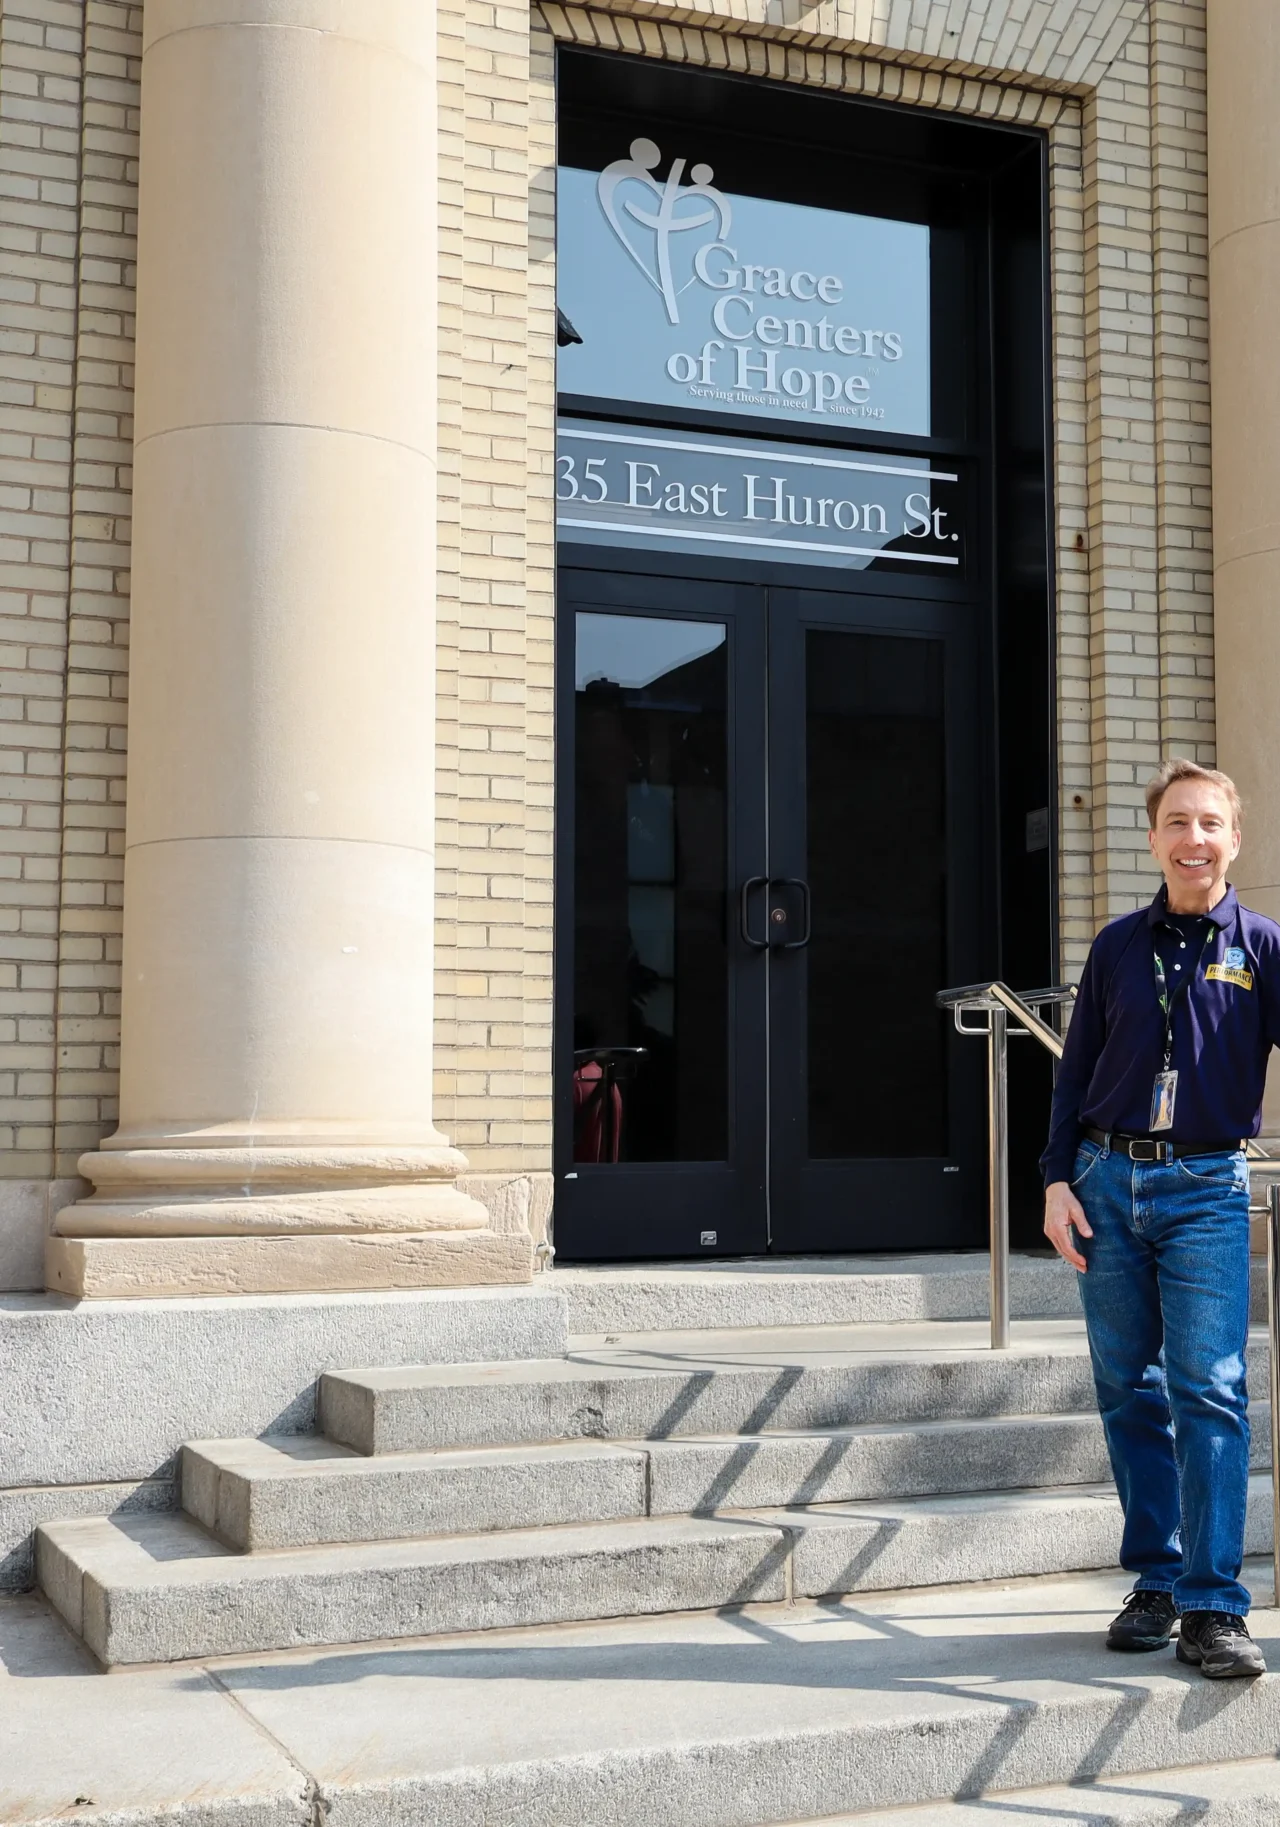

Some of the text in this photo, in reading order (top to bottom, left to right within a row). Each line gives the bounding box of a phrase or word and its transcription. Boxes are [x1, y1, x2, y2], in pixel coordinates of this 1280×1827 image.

[694, 243, 844, 304] Grace
[713, 295, 903, 361] Centers
[667, 340, 870, 412] of Hope
[689, 384, 885, 418] Serving those in need since 1942
[557, 455, 959, 541] 35 East Huron St.
